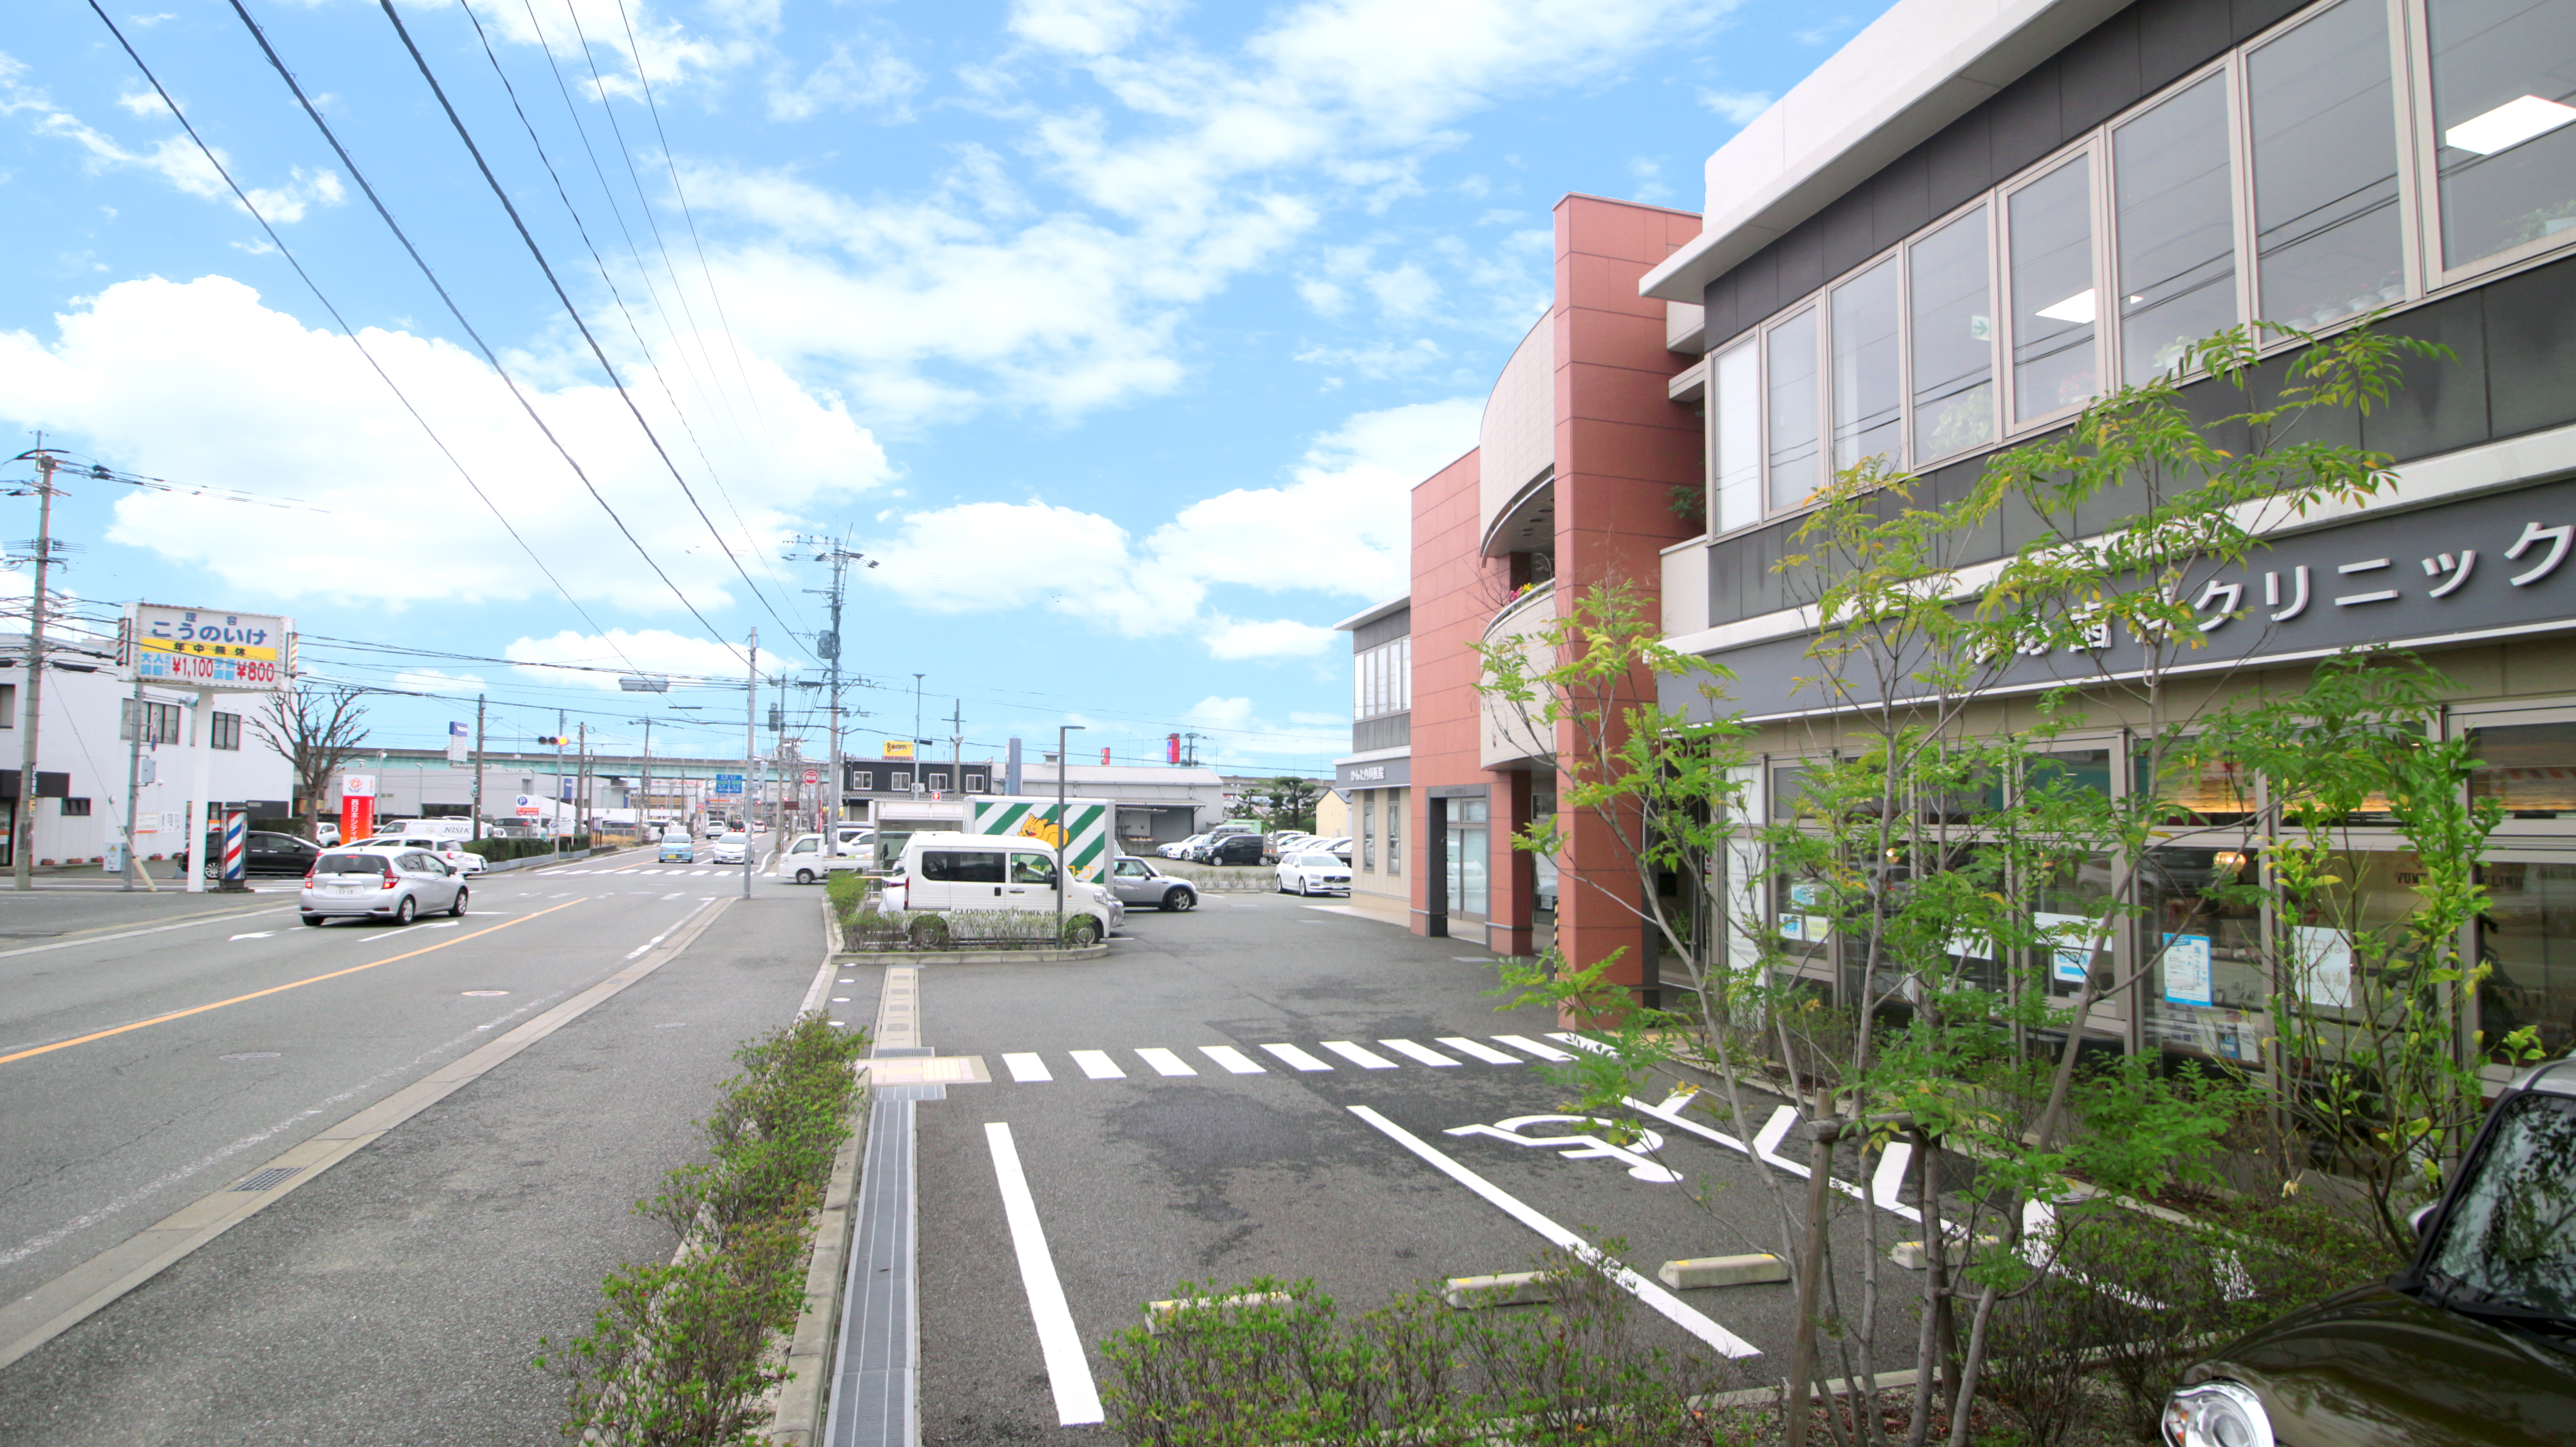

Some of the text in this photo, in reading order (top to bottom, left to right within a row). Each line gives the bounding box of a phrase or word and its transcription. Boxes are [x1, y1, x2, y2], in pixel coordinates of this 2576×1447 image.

[152, 621, 267, 645] こうのいけ
[172, 656, 213, 678] ¥1,100
[237, 660, 274, 682] ¥800
[887, 742, 907, 752] Beam
[1350, 766, 1385, 781] かんた内科医院
